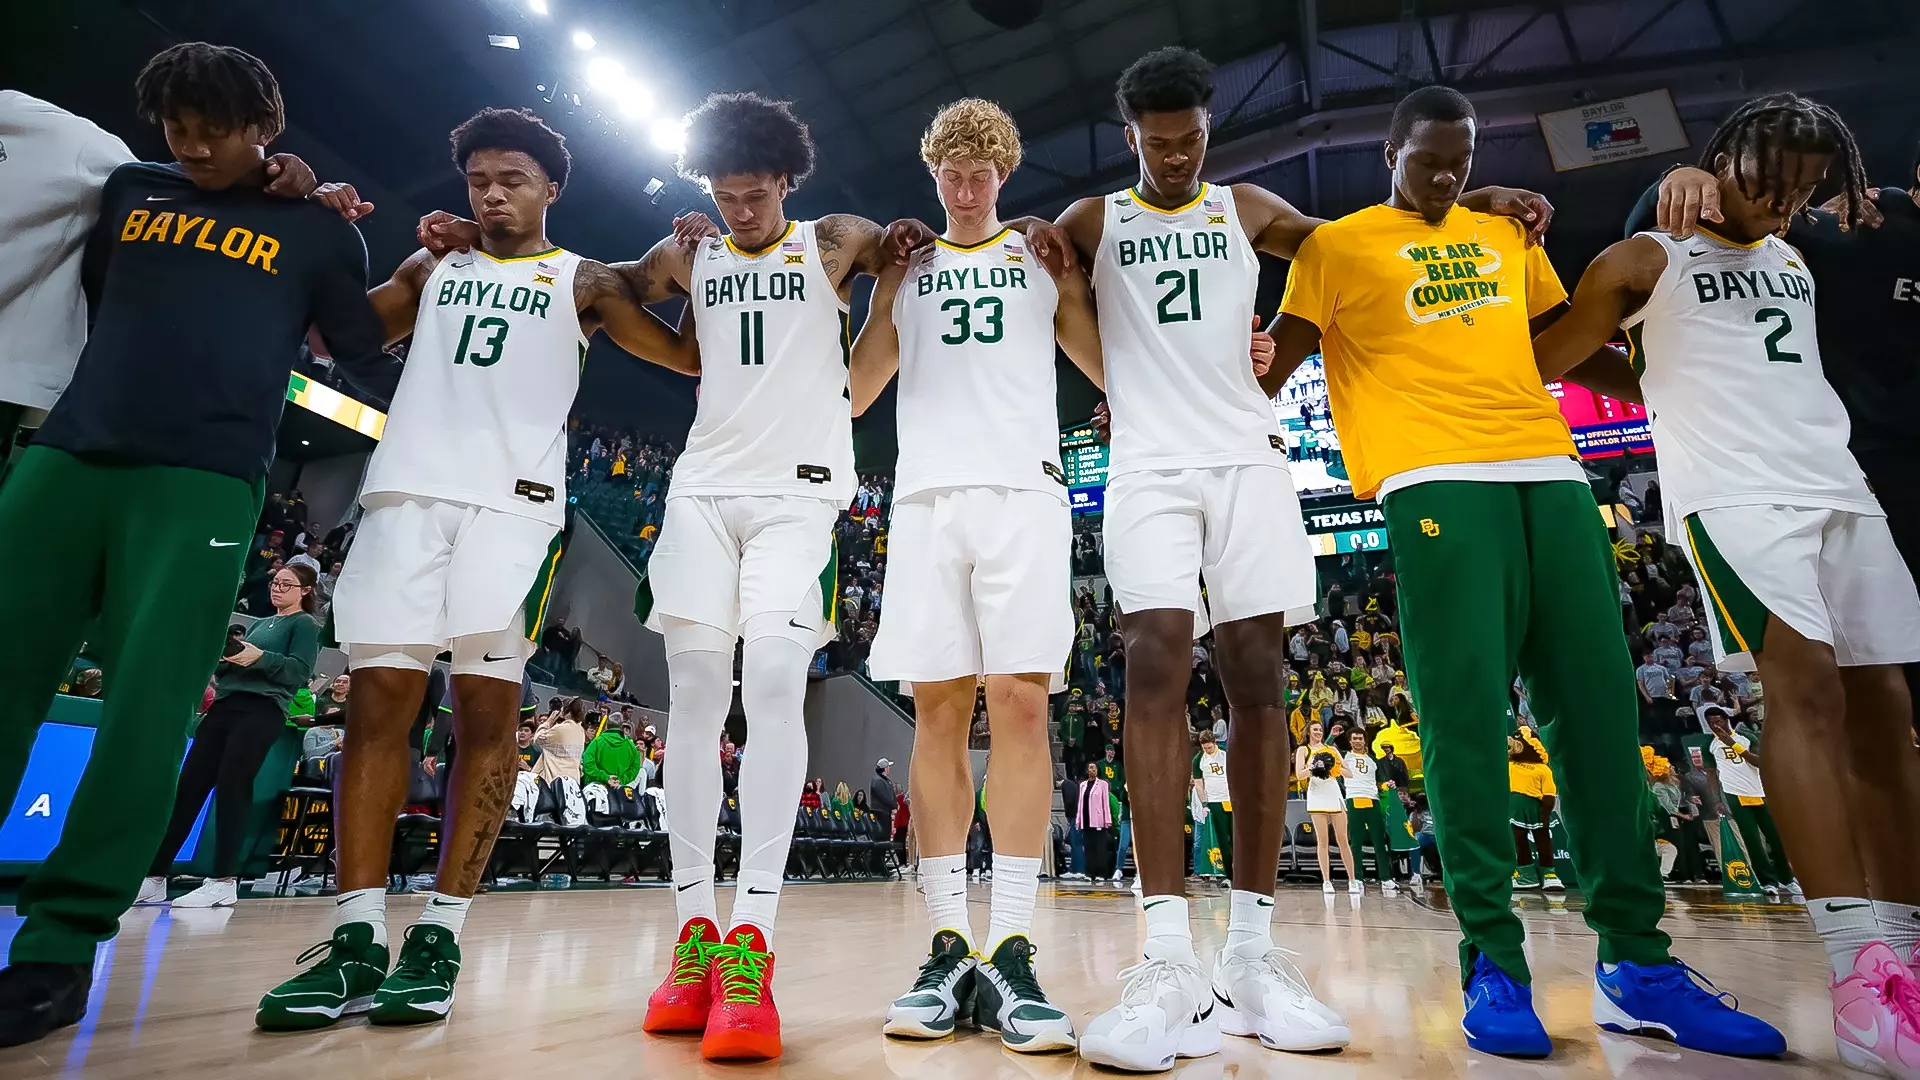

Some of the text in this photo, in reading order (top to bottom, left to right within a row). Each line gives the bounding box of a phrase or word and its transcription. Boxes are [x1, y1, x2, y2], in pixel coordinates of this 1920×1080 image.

[1581, 101, 1626, 118] BAYLOR
[121, 209, 280, 272] BAYLOR
[1119, 231, 1228, 267] BAYLOR
[1407, 242, 1484, 262] WE ARE
[705, 271, 806, 308] BAYLOR
[918, 267, 1028, 297] BAYLOR
[1425, 261, 1480, 282] BEAR
[1692, 271, 1812, 307] BAYLOR
[437, 279, 551, 320] BAYLOR
[1155, 268, 1202, 324] 21
[1413, 281, 1498, 307] COUNTRY
[740, 311, 764, 365] 11
[941, 296, 1003, 345] 33
[1755, 308, 1803, 363] 2
[453, 314, 510, 367] 13
[1586, 429, 1623, 439] OFFICIAL
[1588, 437, 1621, 447] BAYLOR
[1311, 510, 1362, 528] TEXAS
